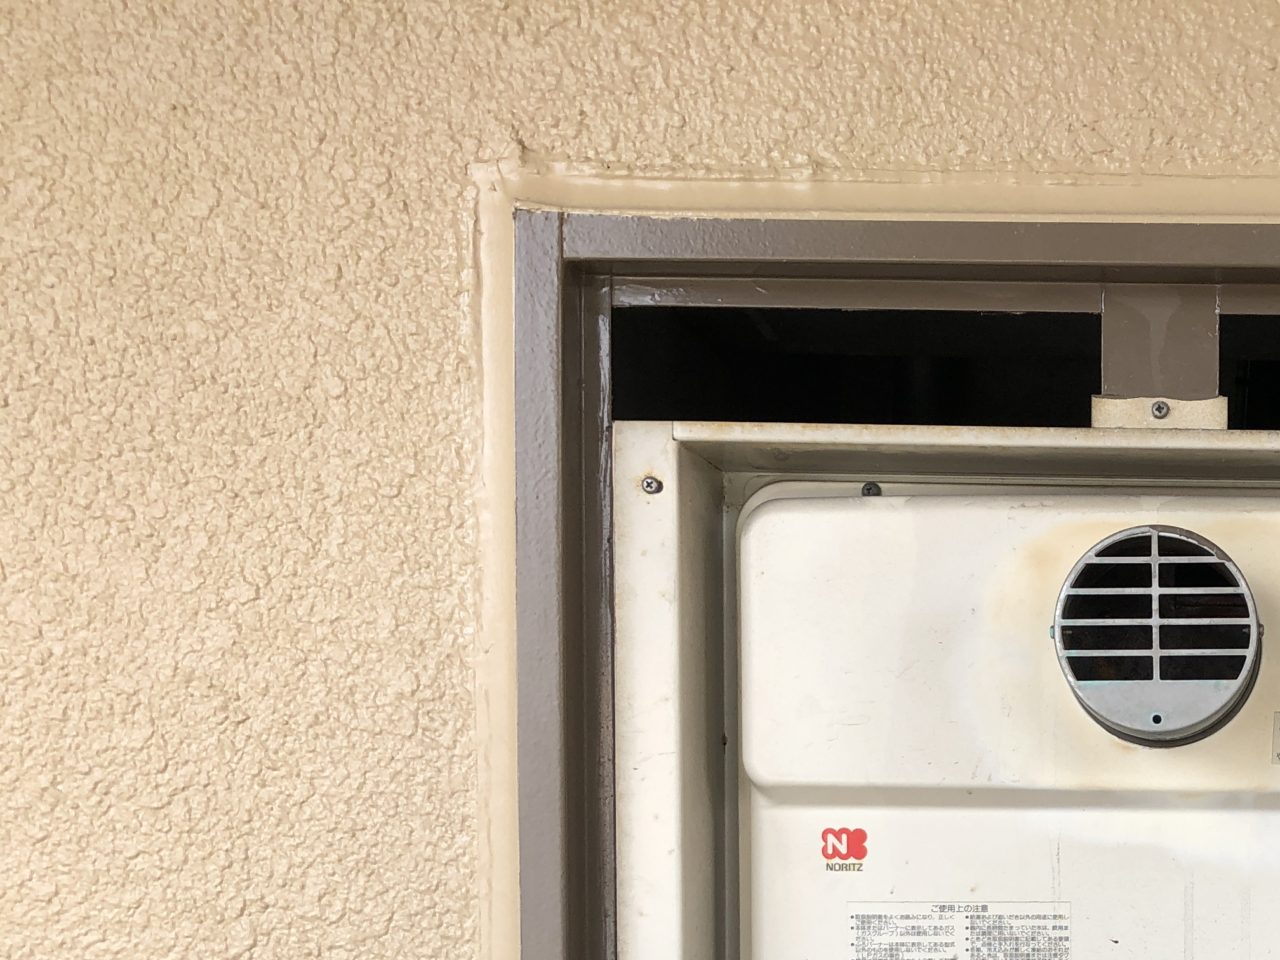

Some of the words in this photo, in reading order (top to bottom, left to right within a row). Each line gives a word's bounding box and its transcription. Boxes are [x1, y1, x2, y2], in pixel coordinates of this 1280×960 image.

[826, 862, 864, 872] NORITZ
[930, 904, 989, 913] ご使用上の注意
